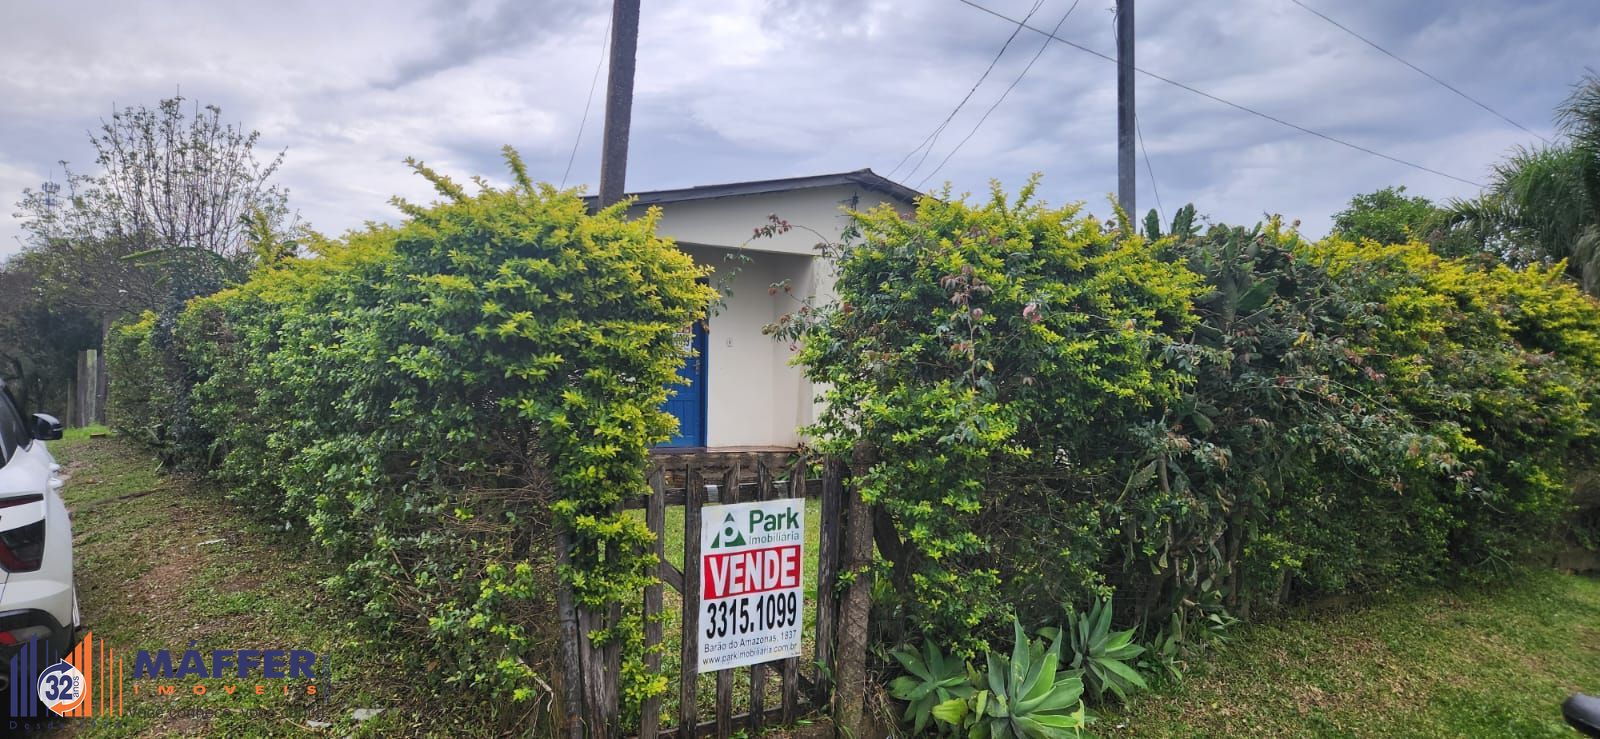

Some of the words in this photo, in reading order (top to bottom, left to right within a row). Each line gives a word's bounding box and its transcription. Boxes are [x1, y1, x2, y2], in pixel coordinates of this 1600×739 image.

[749, 507, 800, 534] Park
[708, 547, 797, 597] VENDE
[706, 591, 797, 639] 3315.1099
[704, 642, 727, 653] Barão
[728, 640, 738, 650] do
